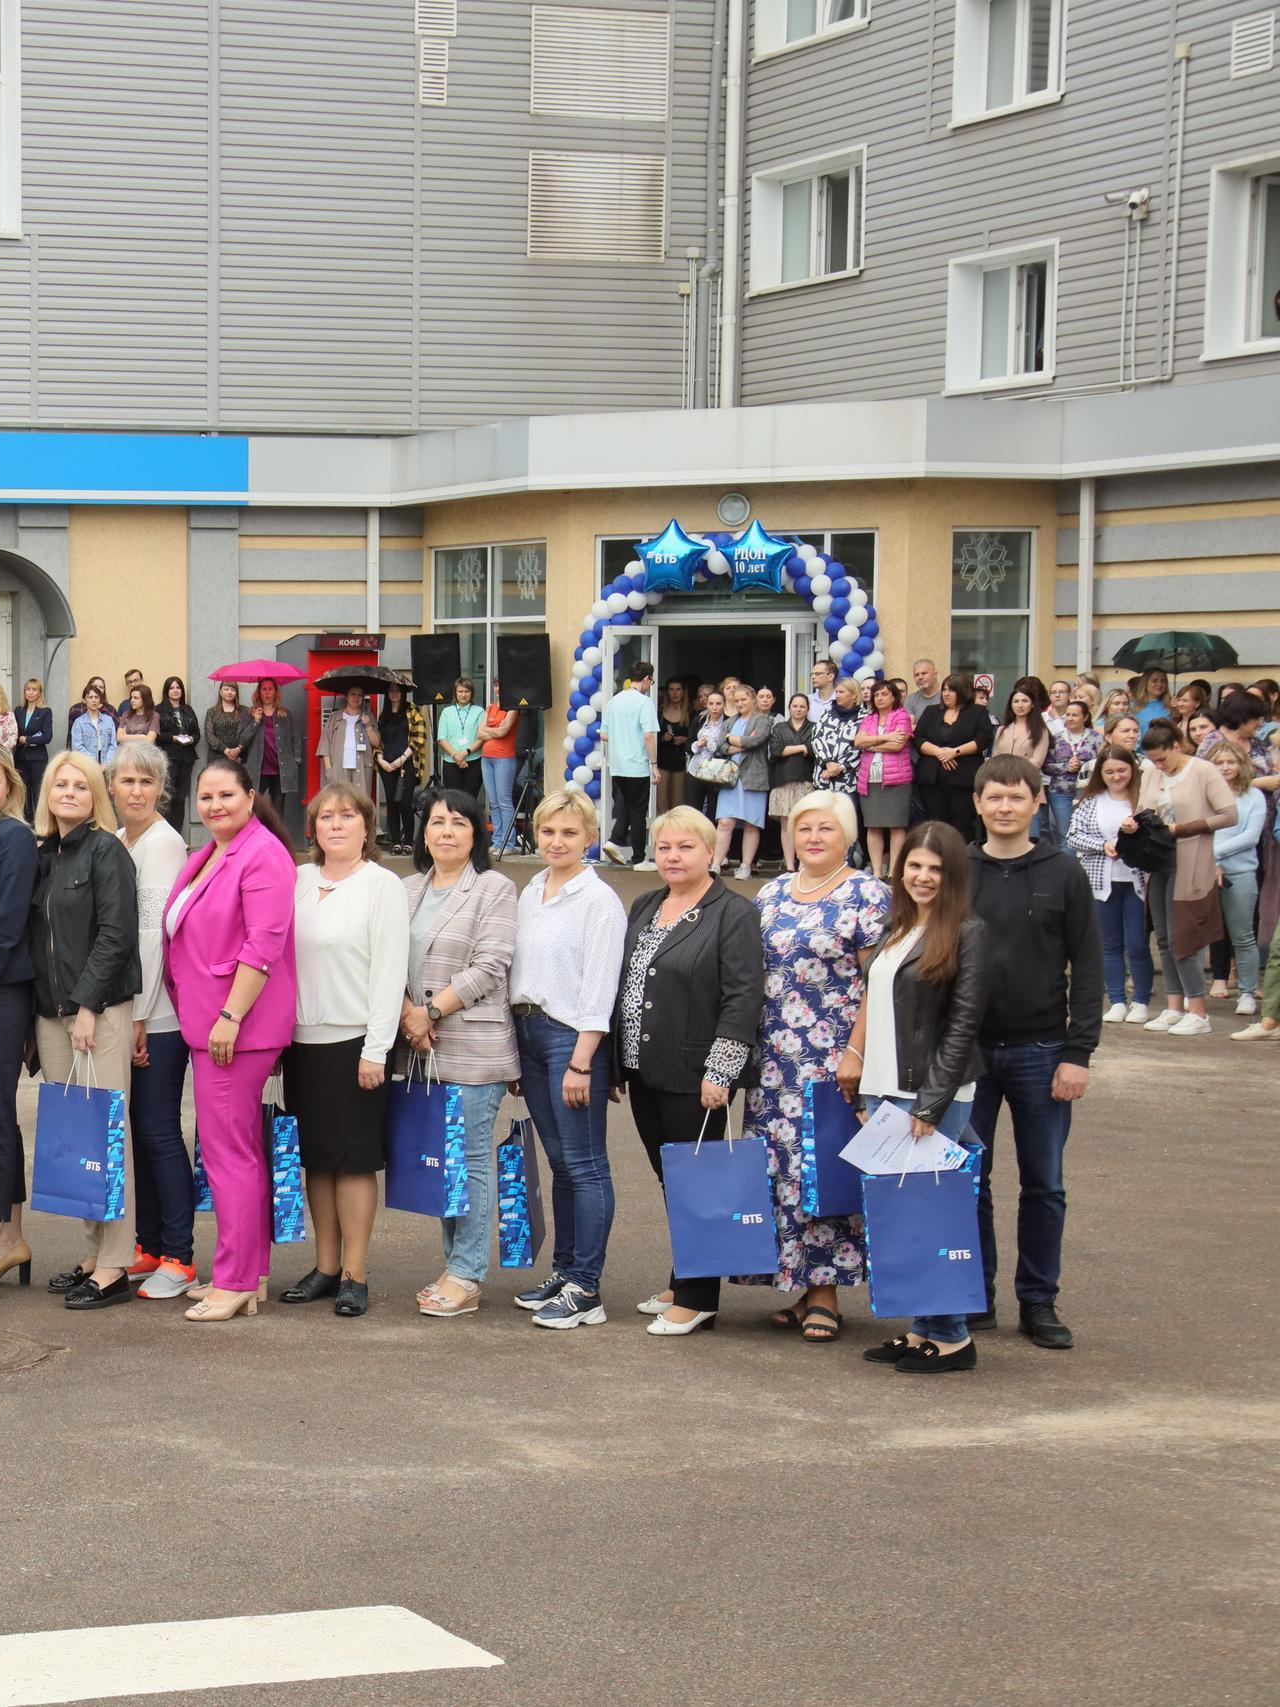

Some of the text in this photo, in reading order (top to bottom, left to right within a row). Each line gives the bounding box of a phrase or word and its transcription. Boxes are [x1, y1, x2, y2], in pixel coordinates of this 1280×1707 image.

[654, 554, 677, 564] ВТБ
[733, 547, 766, 562] РЦОП
[734, 561, 766, 573] 10 лет
[338, 639, 361, 647] КОФЕ
[85, 1160, 101, 1172] ВТБ
[425, 1156, 439, 1168] ВТБ
[741, 1213, 763, 1225] ВТБ
[948, 1249, 971, 1261] ВТБ
